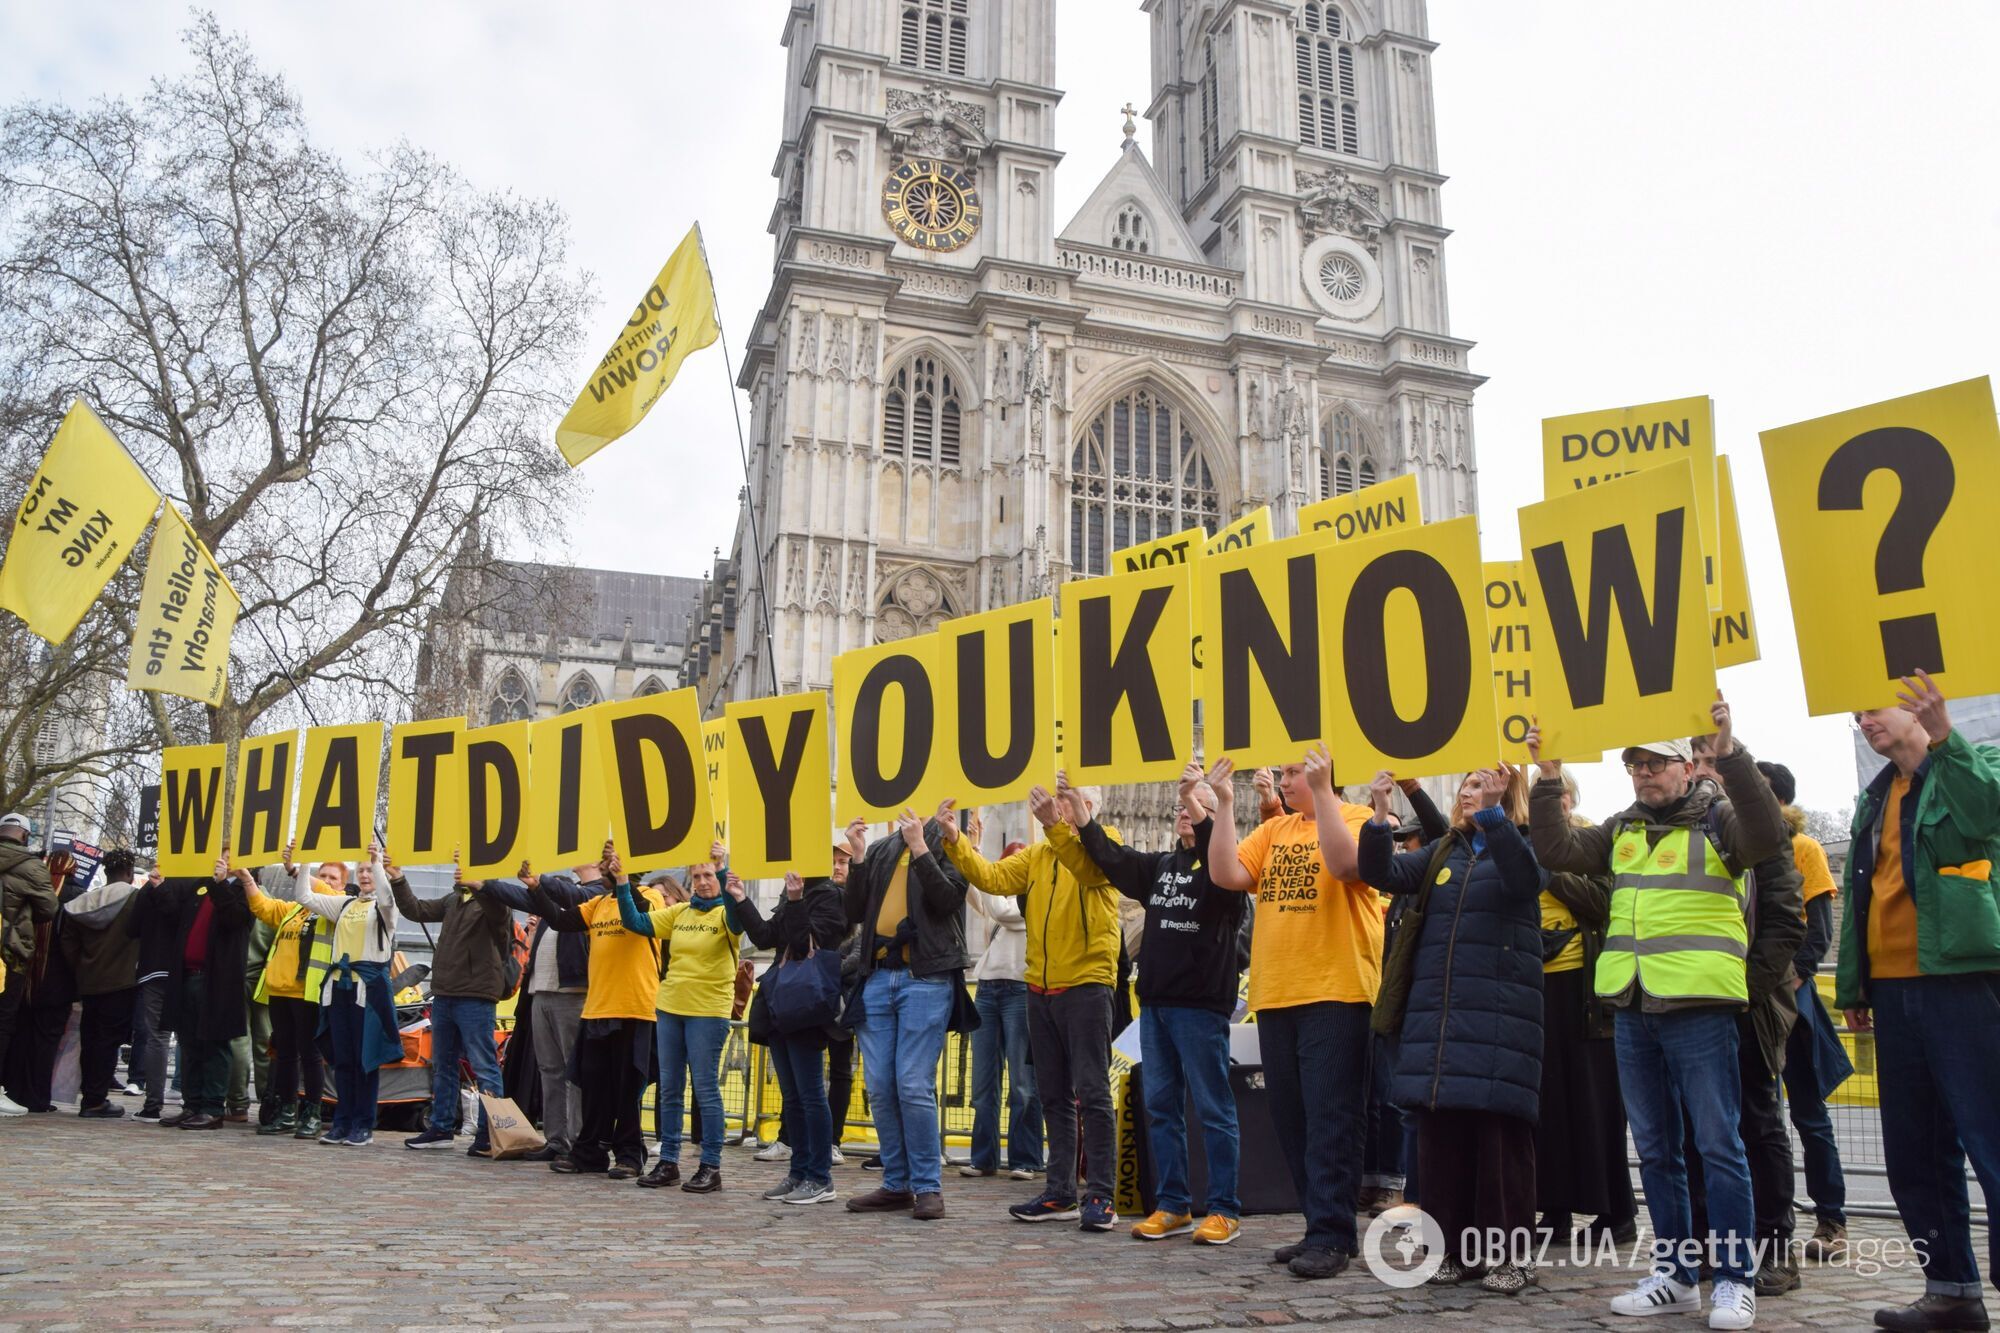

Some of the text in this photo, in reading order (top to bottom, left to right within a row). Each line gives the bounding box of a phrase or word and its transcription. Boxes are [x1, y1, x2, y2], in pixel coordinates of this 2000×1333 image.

[1562, 419, 1690, 463] DOWN
[704, 731, 725, 752] WN
[145, 834, 158, 842] CA
[1270, 863, 1320, 876] QUEENS
[1261, 875, 1315, 889] WE NEED
[1278, 888, 1318, 901] DRAG
[1168, 921, 1200, 930] Republic
[1118, 1127, 1136, 1209] KNOW?
